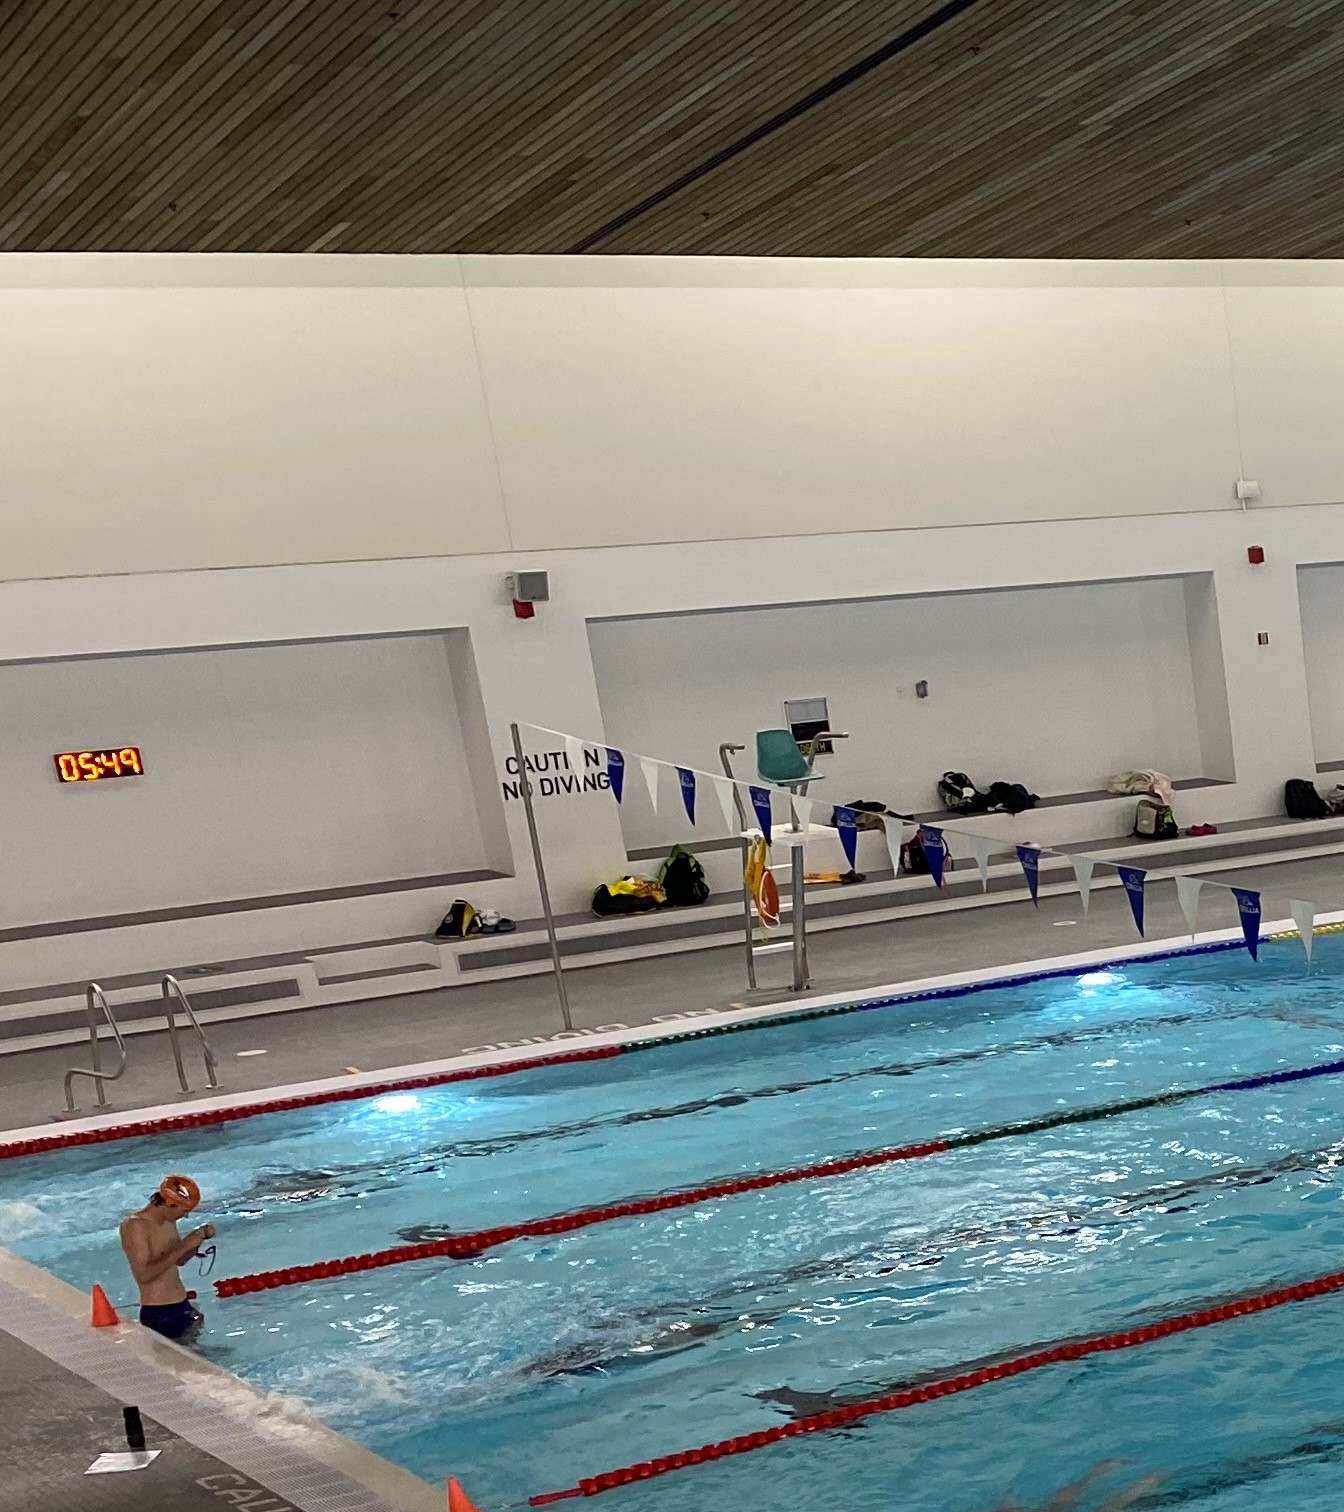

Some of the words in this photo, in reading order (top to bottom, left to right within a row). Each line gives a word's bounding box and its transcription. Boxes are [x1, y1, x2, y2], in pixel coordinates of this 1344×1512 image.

[58, 748, 140, 782] 05:49
[505, 748, 600, 775] CAUTIN
[540, 772, 611, 797] DIVING
